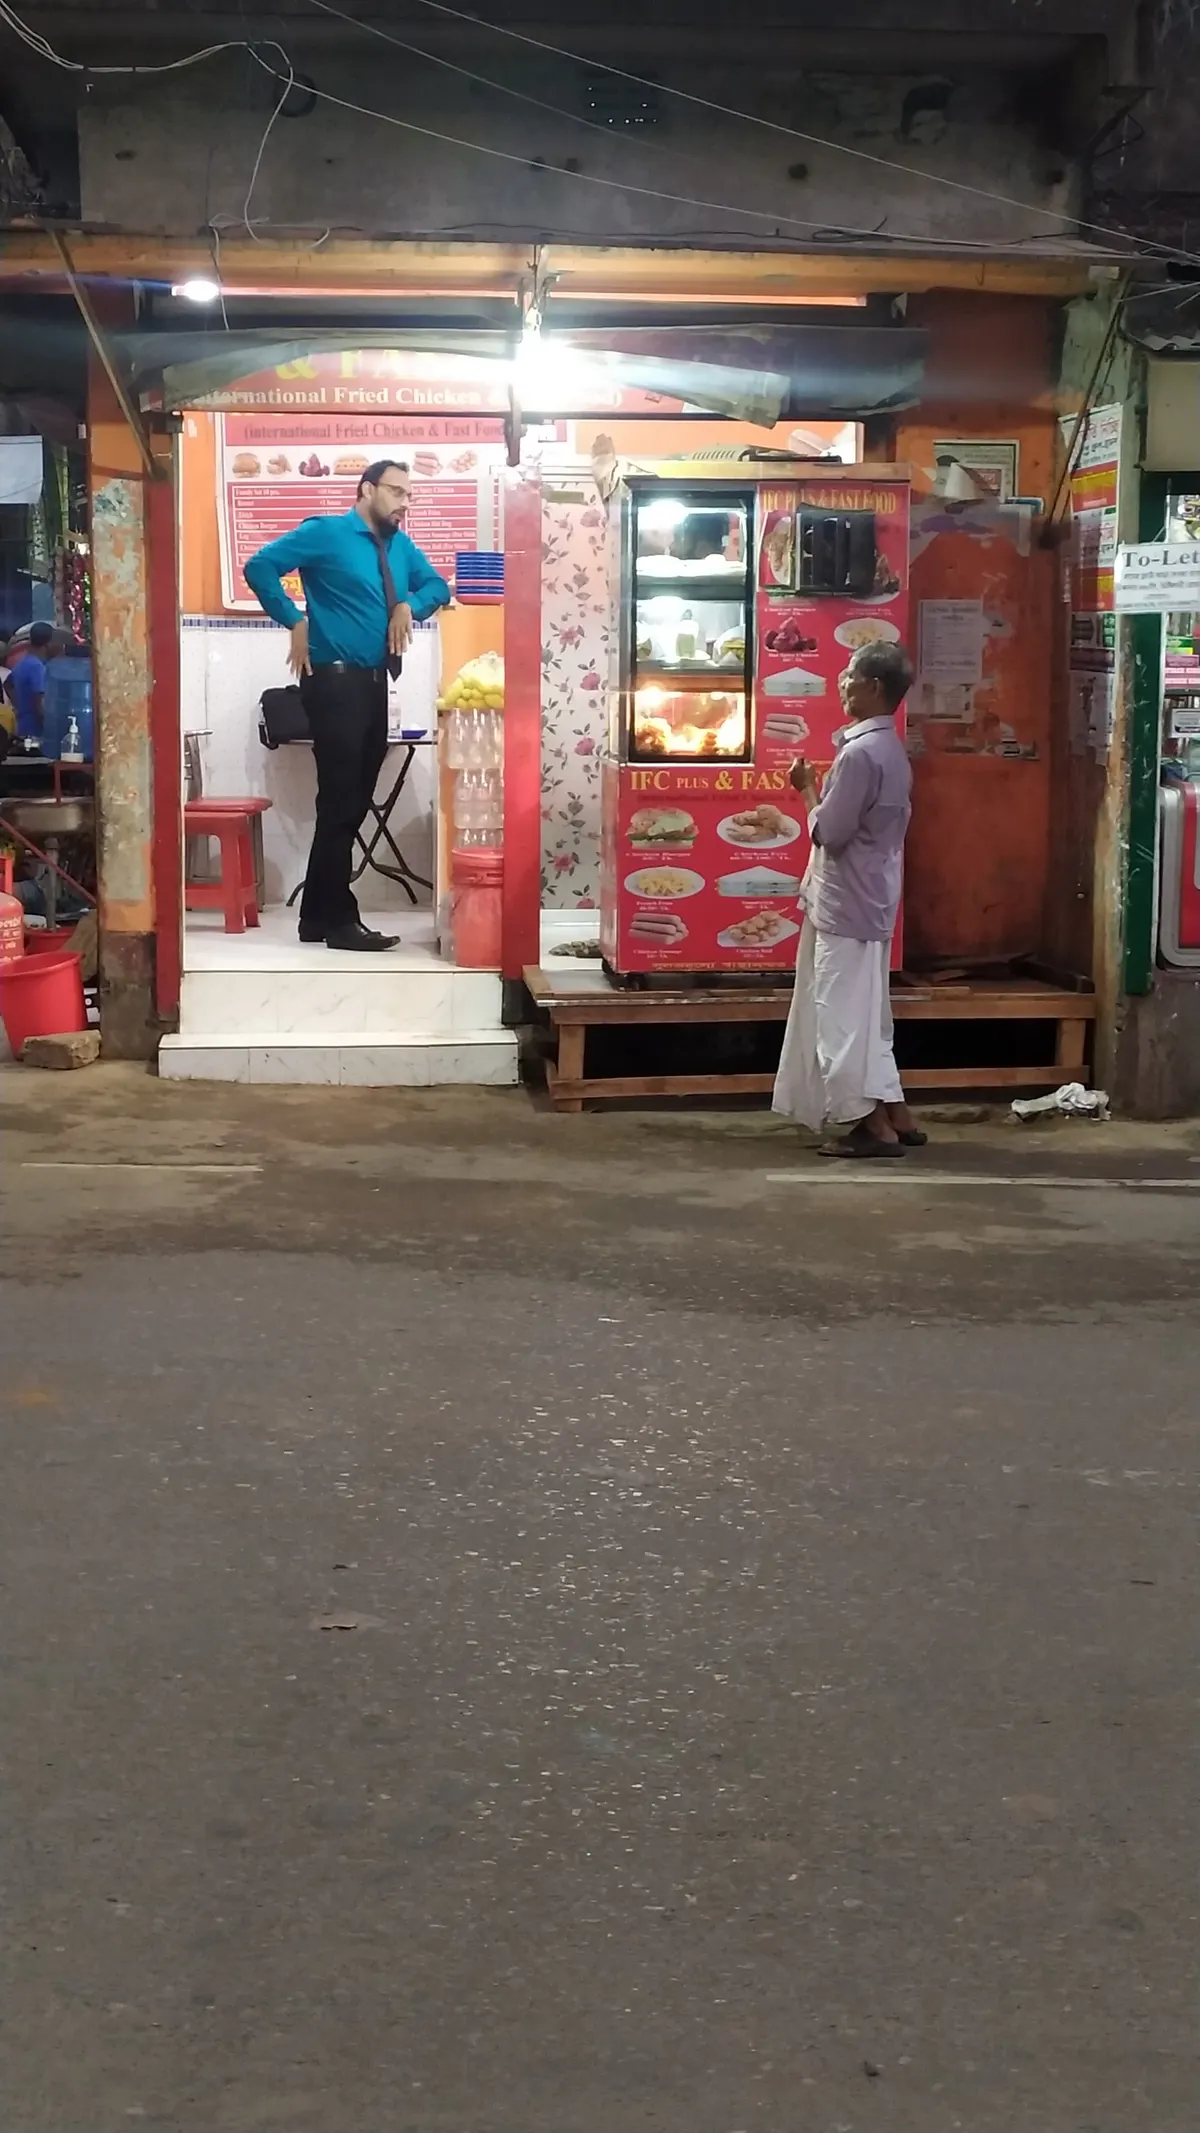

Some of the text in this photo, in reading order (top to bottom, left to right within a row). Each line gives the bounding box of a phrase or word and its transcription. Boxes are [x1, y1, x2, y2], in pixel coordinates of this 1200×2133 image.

[334, 387, 389, 404] Fried
[396, 387, 481, 405] Chicken
[336, 423, 369, 438] Fried
[373, 422, 425, 438] Chicken
[428, 423, 439, 437] &
[444, 422, 471, 437] Fast
[1121, 549, 1200, 568] To-Let
[630, 770, 671, 791] IFC
[676, 777, 709, 789] PLUS
[714, 770, 734, 791] &
